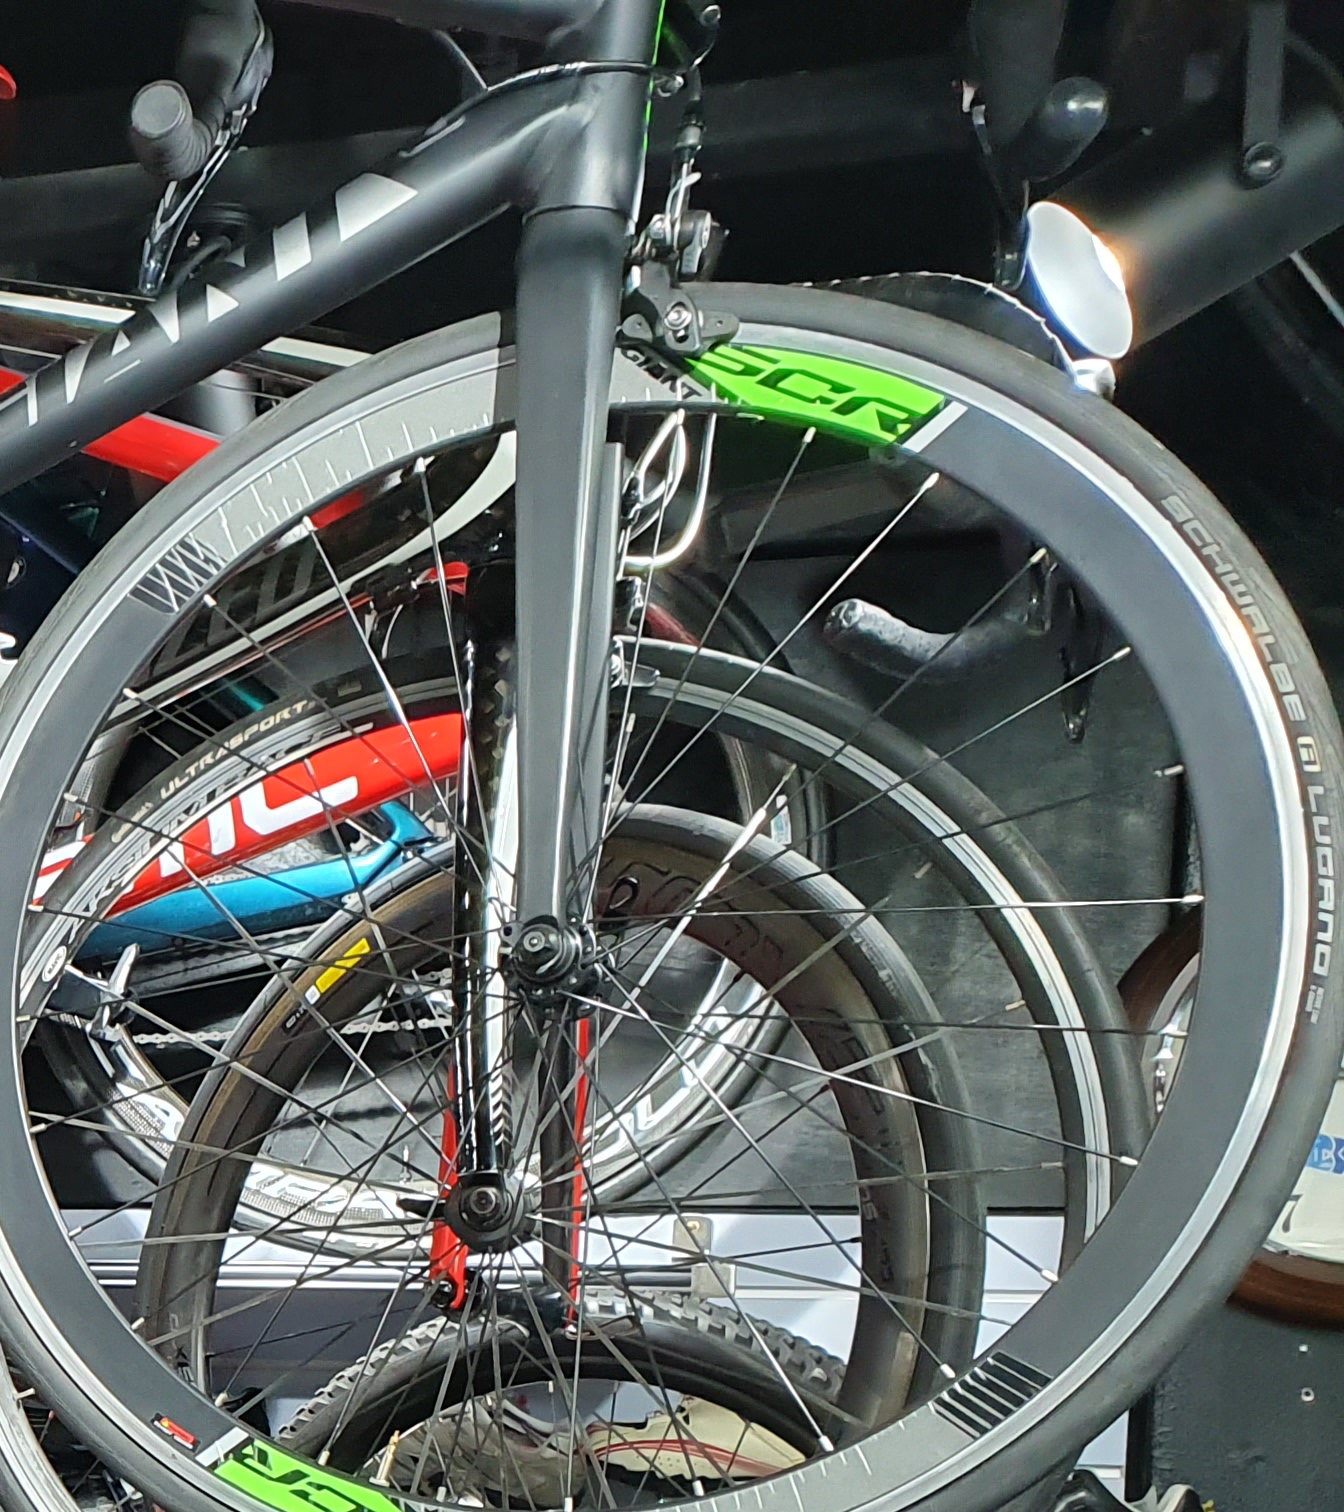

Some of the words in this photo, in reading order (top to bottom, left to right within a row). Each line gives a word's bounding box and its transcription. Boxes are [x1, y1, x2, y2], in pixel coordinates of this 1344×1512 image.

[158, 697, 310, 800] ULTRASPORT
[1160, 495, 1308, 723] SCHWALBE
[1306, 784, 1337, 990] LUGANO
